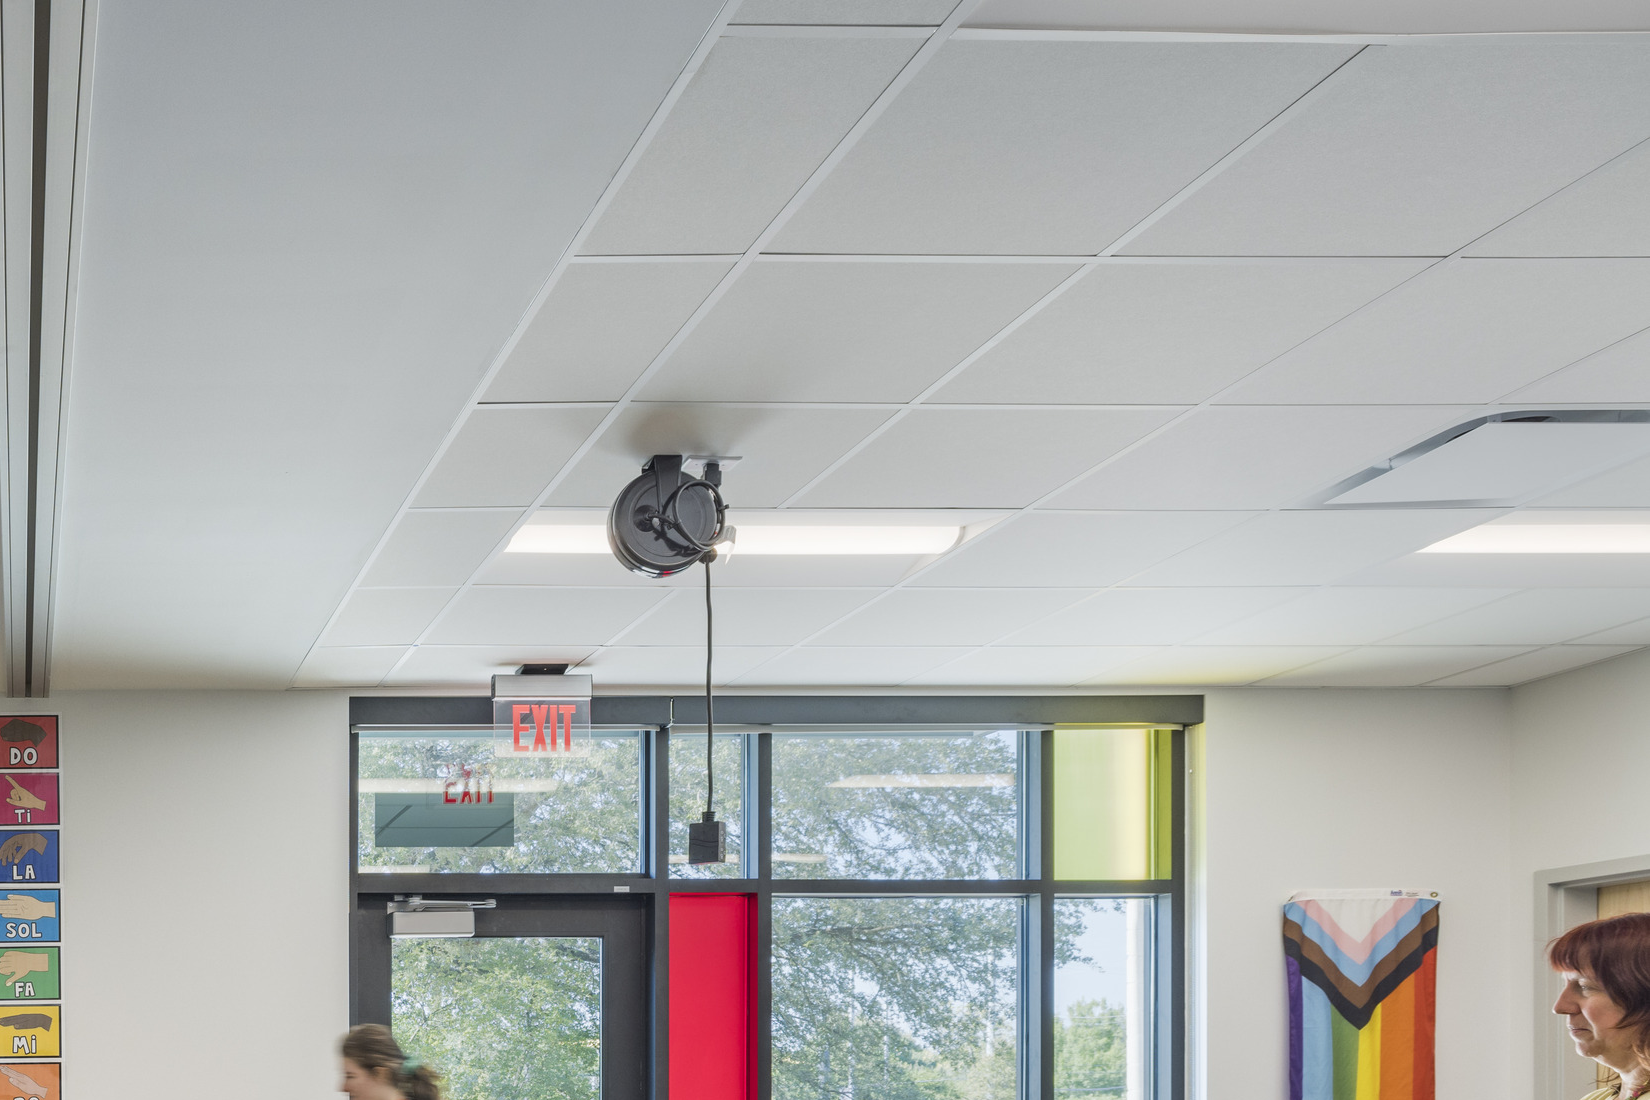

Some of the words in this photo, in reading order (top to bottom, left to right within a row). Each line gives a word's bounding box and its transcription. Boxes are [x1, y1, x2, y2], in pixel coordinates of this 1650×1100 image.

[512, 704, 577, 752] EXIT
[9, 747, 38, 765] DO
[14, 809, 32, 823] Ti
[12, 864, 36, 880] LA
[6, 922, 42, 938] SOL
[14, 981, 36, 998] FA
[12, 1035, 37, 1054] Mi
